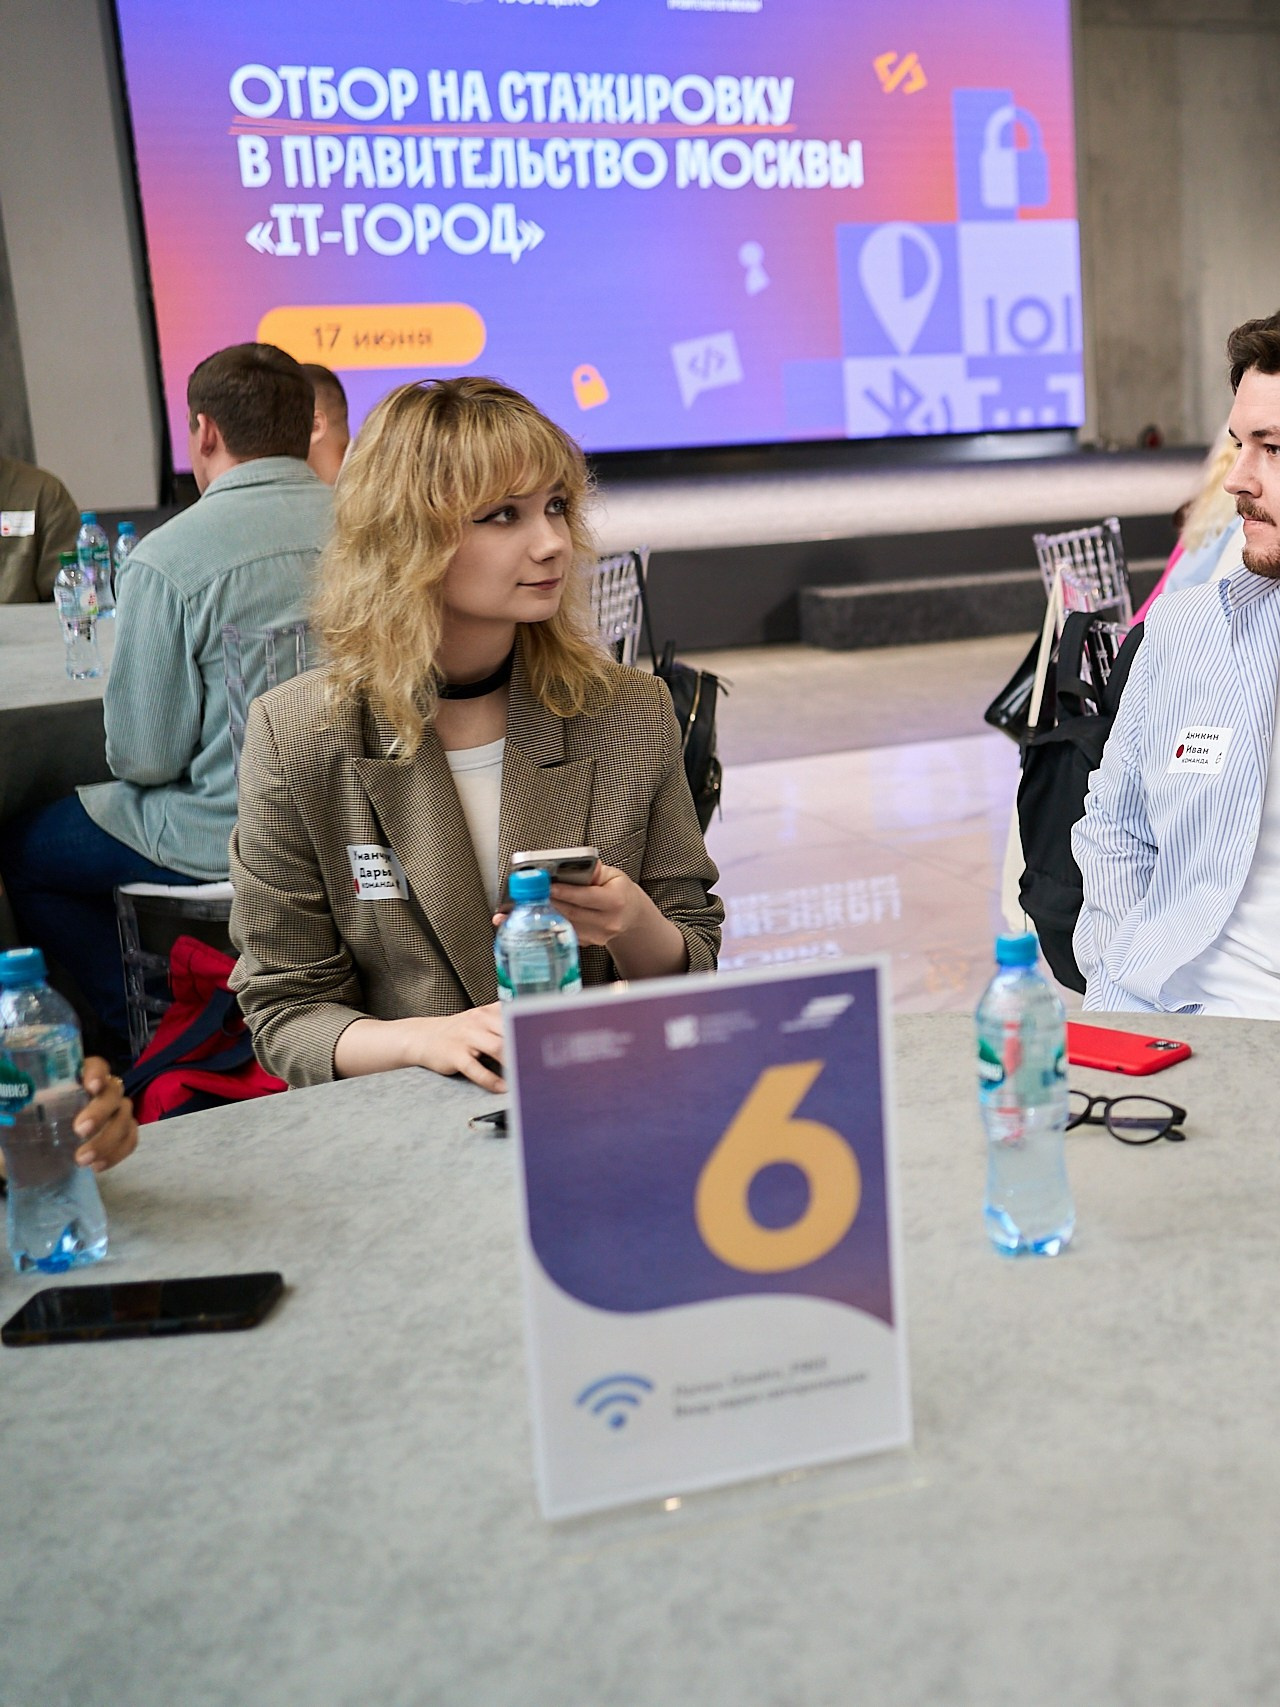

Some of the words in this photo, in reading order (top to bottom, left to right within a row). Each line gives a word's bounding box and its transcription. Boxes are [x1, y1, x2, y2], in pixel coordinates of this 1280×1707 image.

[229, 64, 419, 121] ОТБОР
[427, 69, 492, 122] НА
[498, 70, 794, 126] СТАЖИРОВКУ
[237, 134, 272, 188] В
[281, 134, 668, 190] ПРАВИТЕЛЬСТВО
[675, 138, 864, 190] МОСКВЫ
[313, 323, 342, 352] 17
[353, 327, 434, 350] июня
[1186, 731, 1219, 740] Аникин
[1186, 744, 1209, 754] Иван
[694, 1058, 862, 1274] 6
